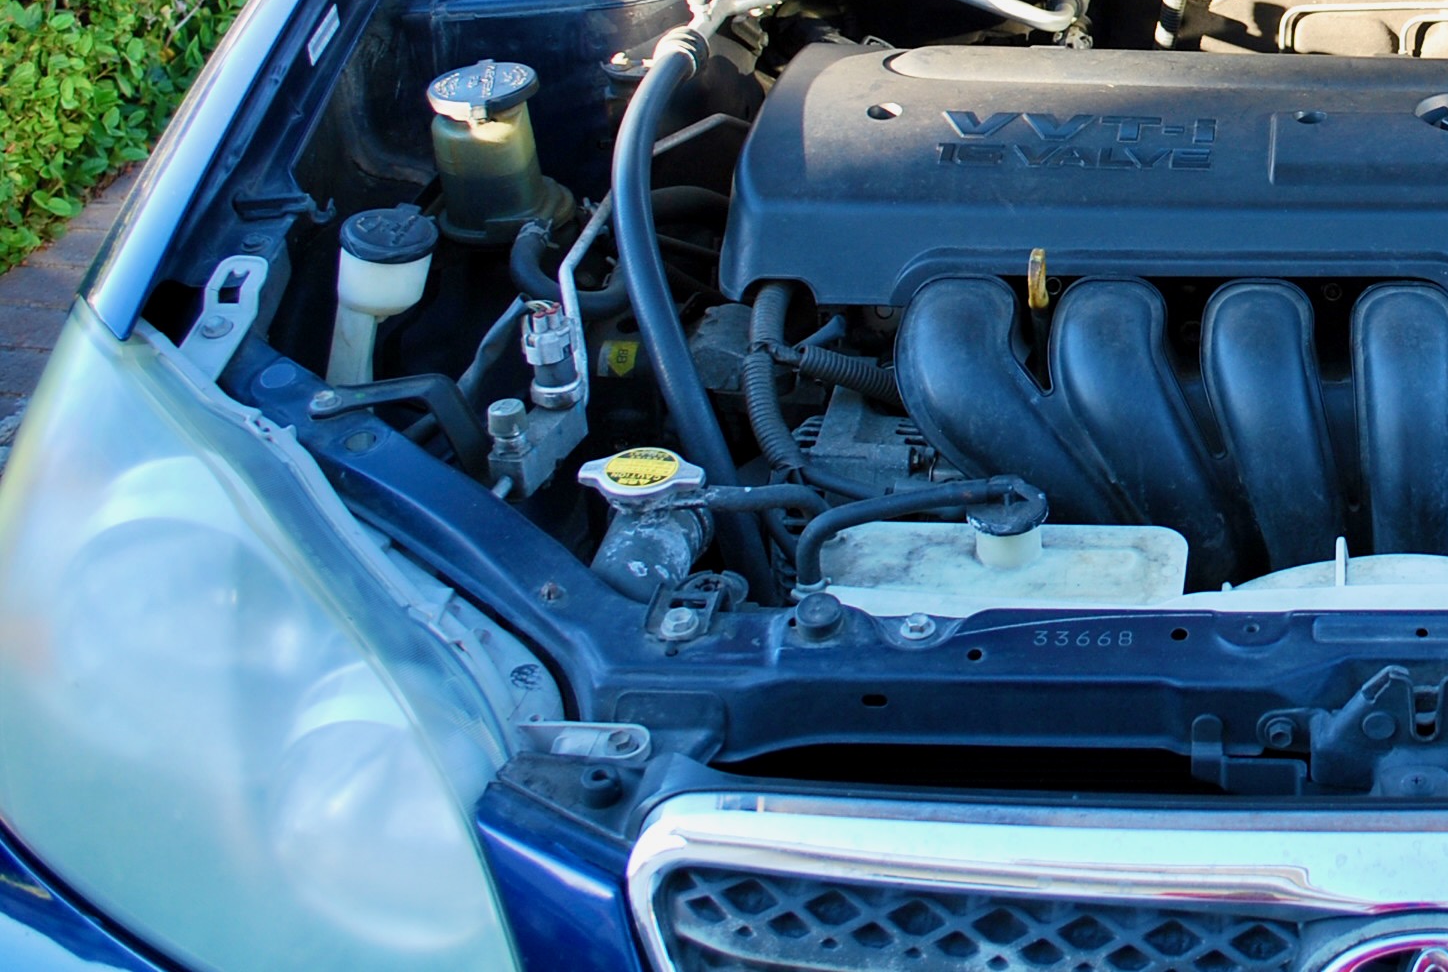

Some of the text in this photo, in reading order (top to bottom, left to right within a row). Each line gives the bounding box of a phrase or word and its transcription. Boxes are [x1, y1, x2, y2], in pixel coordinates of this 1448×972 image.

[1013, 143, 1212, 170] VALVE
[610, 471, 662, 481] CAUTION
[1033, 630, 1133, 647] 33668
